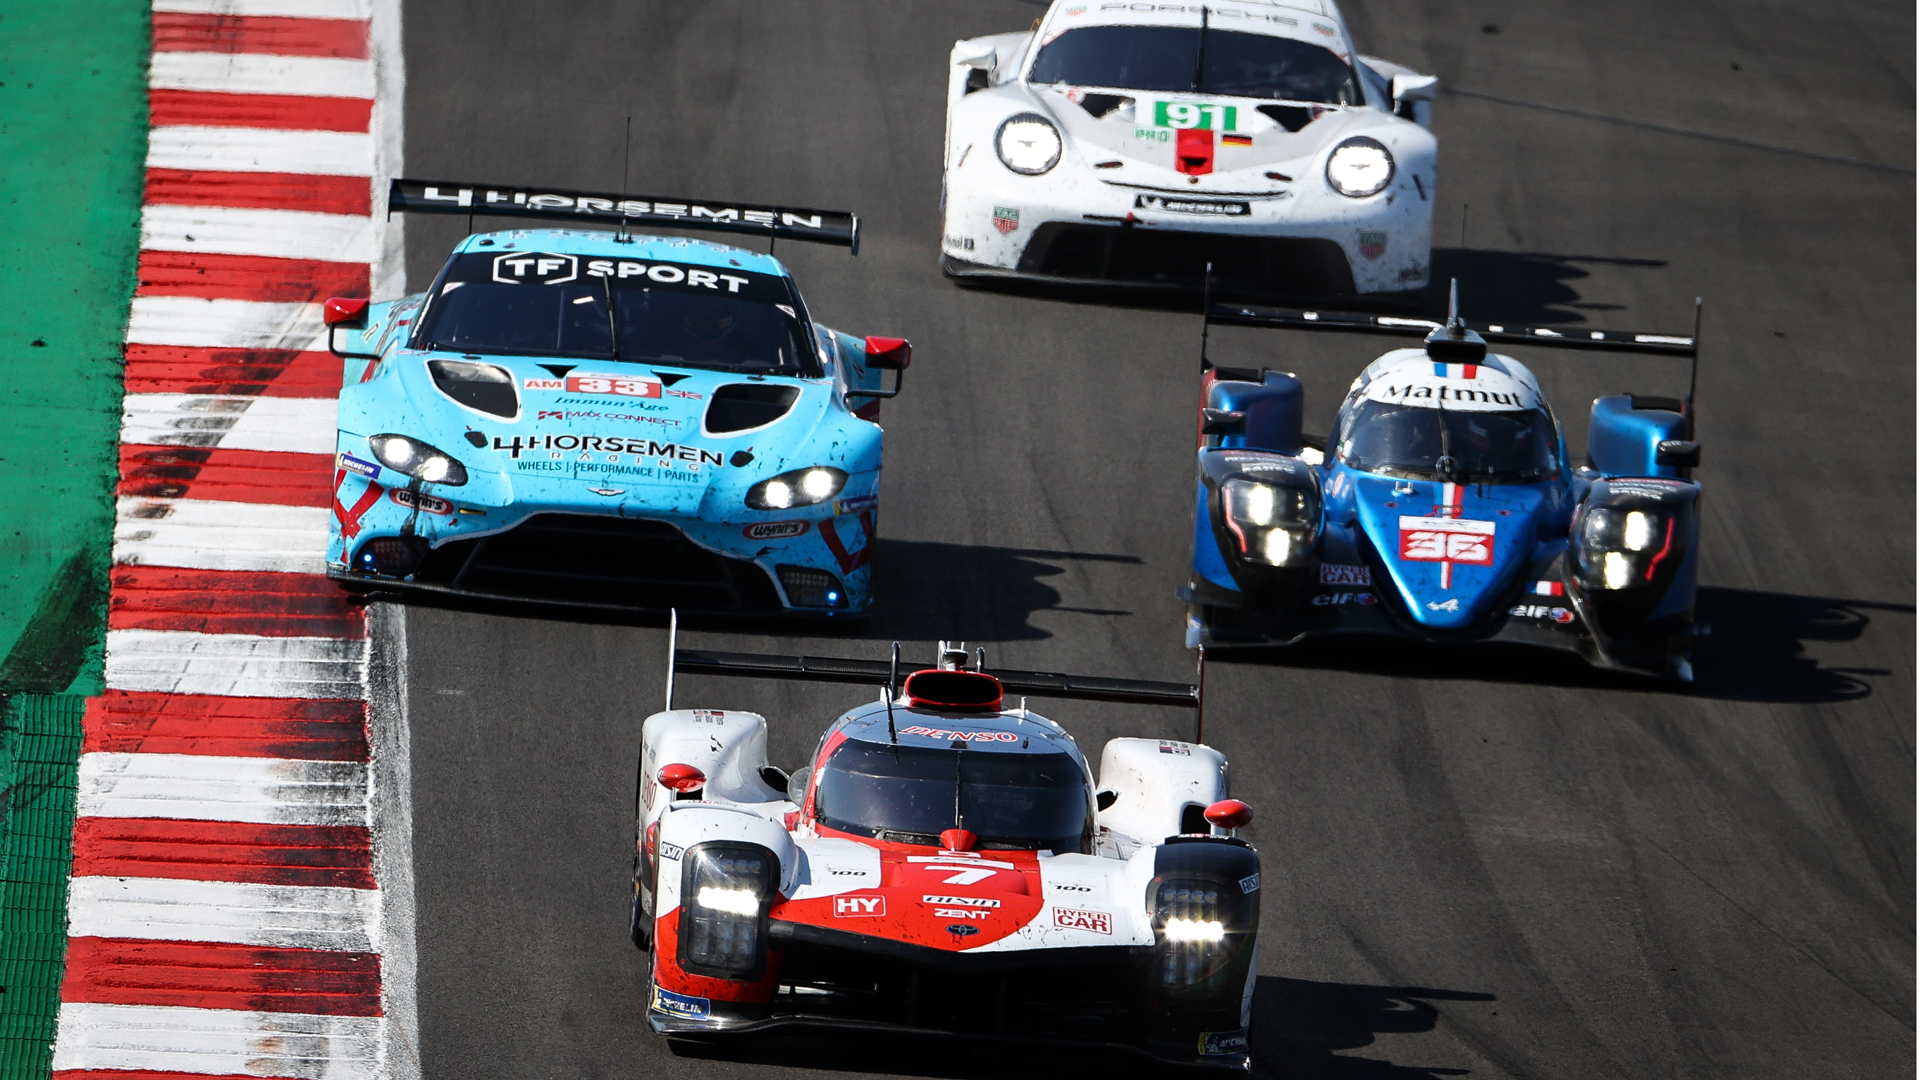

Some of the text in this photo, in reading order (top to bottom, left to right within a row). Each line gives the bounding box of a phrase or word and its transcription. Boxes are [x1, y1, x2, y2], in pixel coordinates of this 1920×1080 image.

[1166, 103, 1224, 130] 91
[505, 258, 750, 293] TF SPORT
[525, 378, 649, 397] AM 33
[1382, 383, 1524, 408] Matmut
[604, 412, 682, 426] CONNECT
[551, 451, 700, 471] RACING
[517, 461, 700, 483] WHEELS PERFORMANCE PARTS
[1403, 531, 1489, 562] 36
[1323, 572, 1368, 584] CAR
[898, 725, 1019, 743] DENSO
[924, 865, 998, 886] 7
[837, 898, 880, 913] HY
[934, 907, 991, 920] ZENT
[1057, 908, 1107, 921] HYPER
[1058, 914, 1108, 932] CAR
